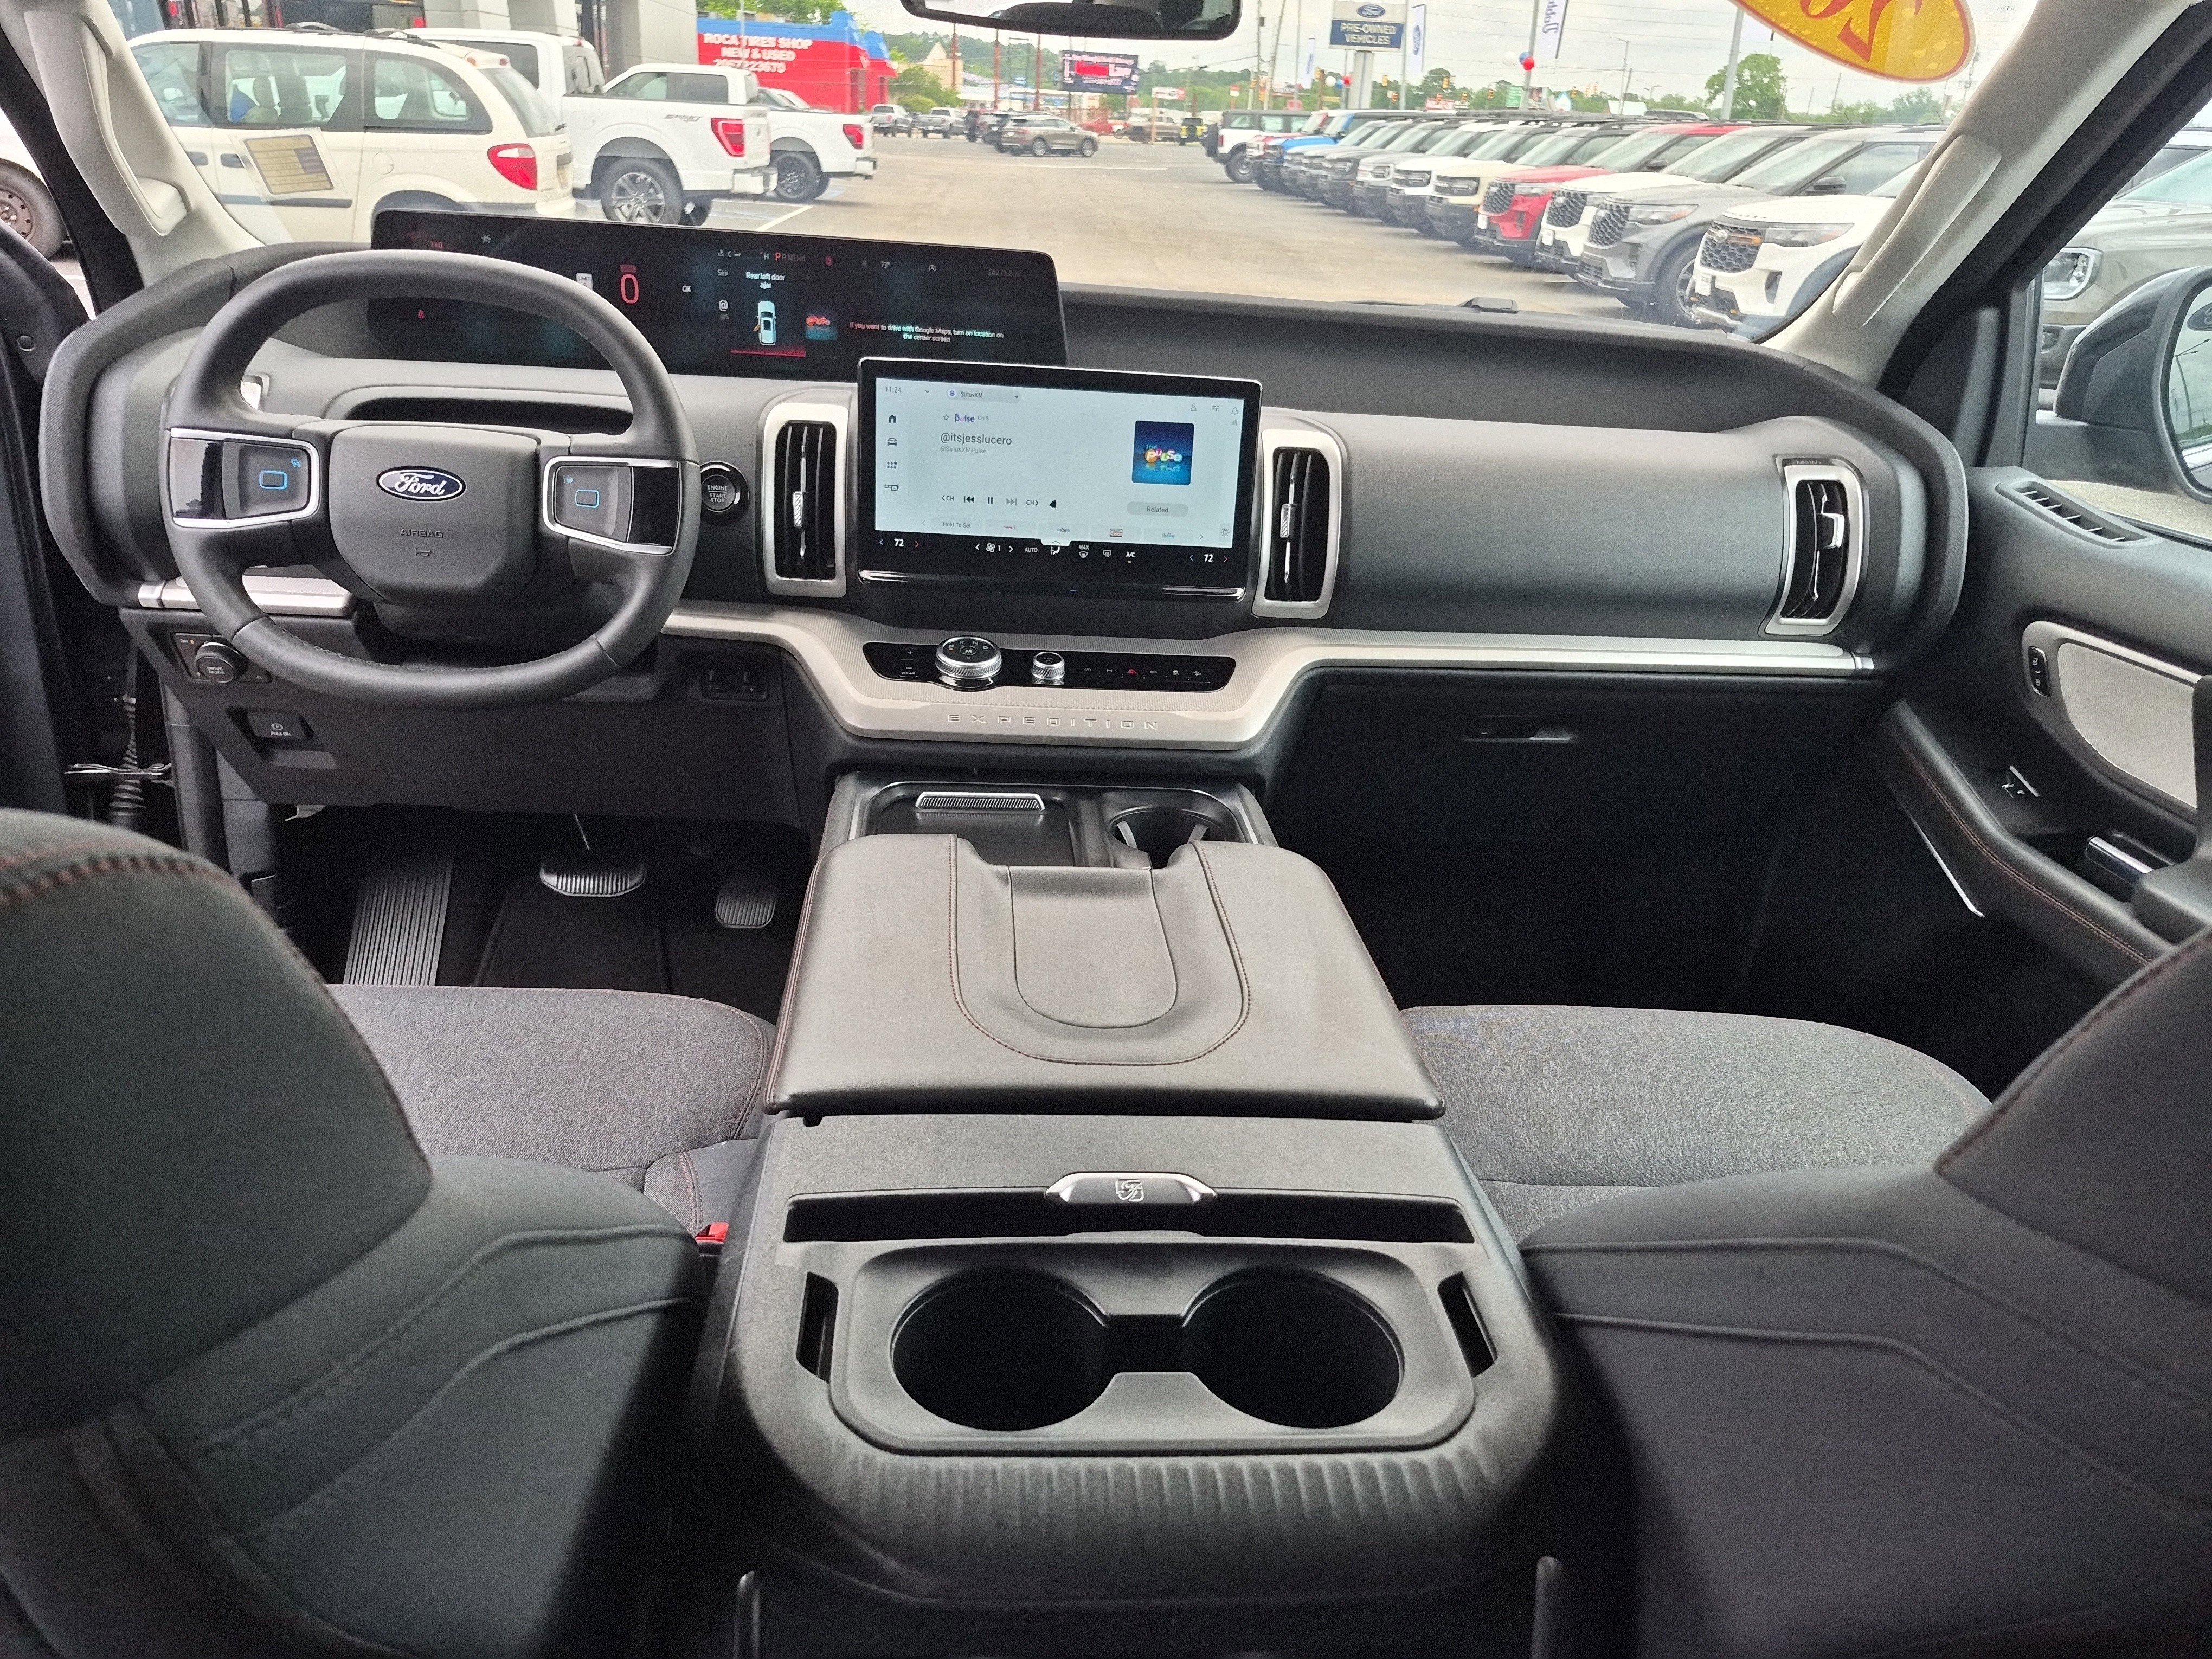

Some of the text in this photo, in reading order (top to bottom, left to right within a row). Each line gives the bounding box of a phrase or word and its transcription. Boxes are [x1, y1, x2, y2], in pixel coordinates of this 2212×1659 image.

[1340, 23, 1397, 34] PRE-OWNED
[704, 33, 813, 49] ROCA TIRES SHOP
[1345, 34, 1391, 44] VEHICLES
[721, 47, 796, 61] NEW & USED
[745, 272, 760, 280] Rear
[620, 274, 639, 304] 0
[915, 326, 935, 335] Google
[935, 327, 953, 336] Maps,
[973, 330, 996, 338] location
[941, 433, 1012, 445] @itsjesslucero
[940, 446, 987, 454] @SiriusXMPulse
[394, 472, 447, 496] Ford
[400, 528, 444, 538] AIRBAG
[894, 538, 904, 547] 72
[1204, 554, 1214, 562] 72
[947, 714, 1158, 730] EXPEDITION
